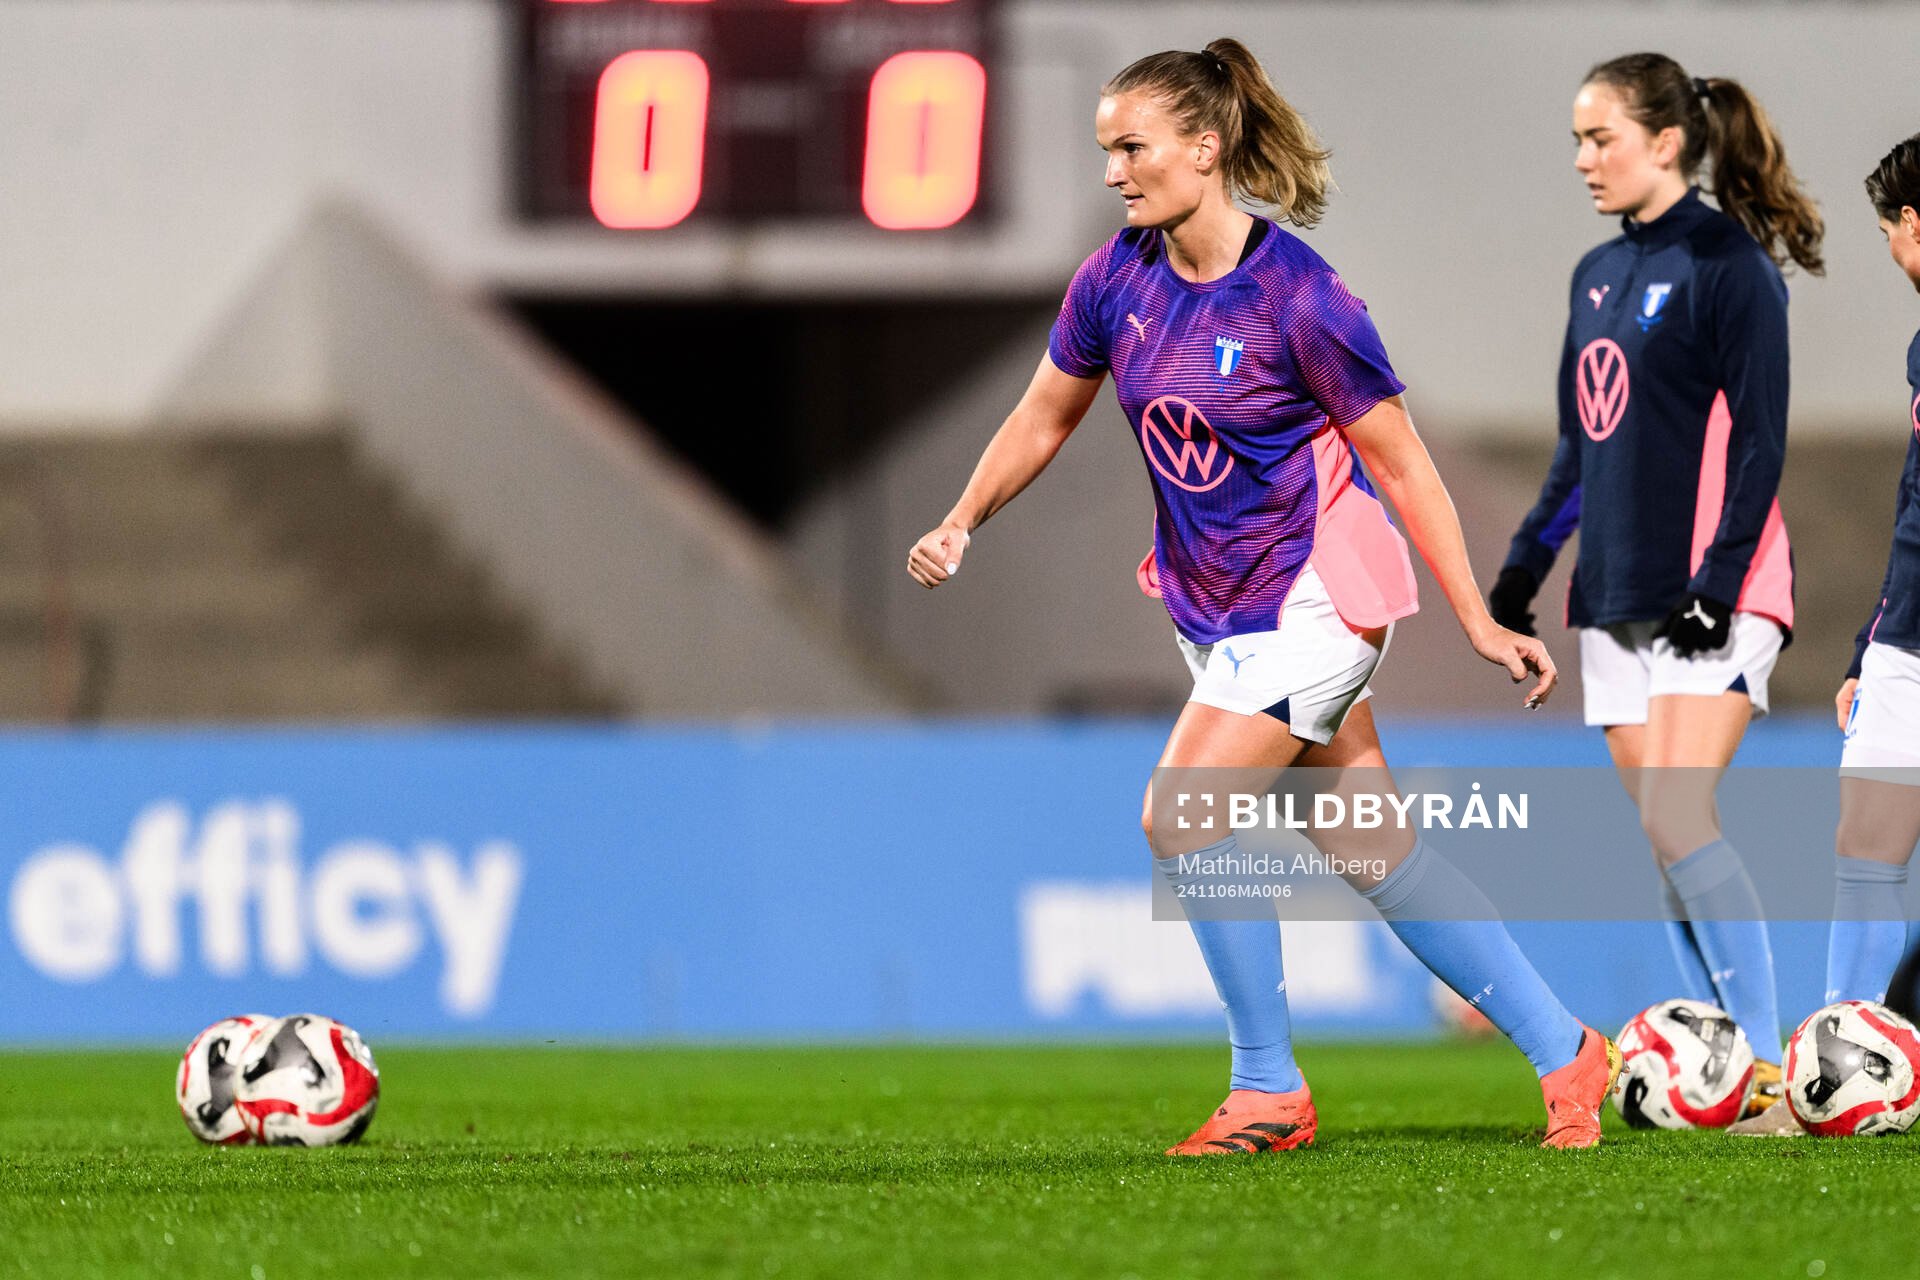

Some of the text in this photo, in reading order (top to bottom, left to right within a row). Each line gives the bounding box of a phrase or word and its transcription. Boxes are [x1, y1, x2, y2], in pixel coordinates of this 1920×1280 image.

[588, 49, 711, 230] 0
[861, 50, 987, 230] 0
[11, 803, 520, 1019] efficy
